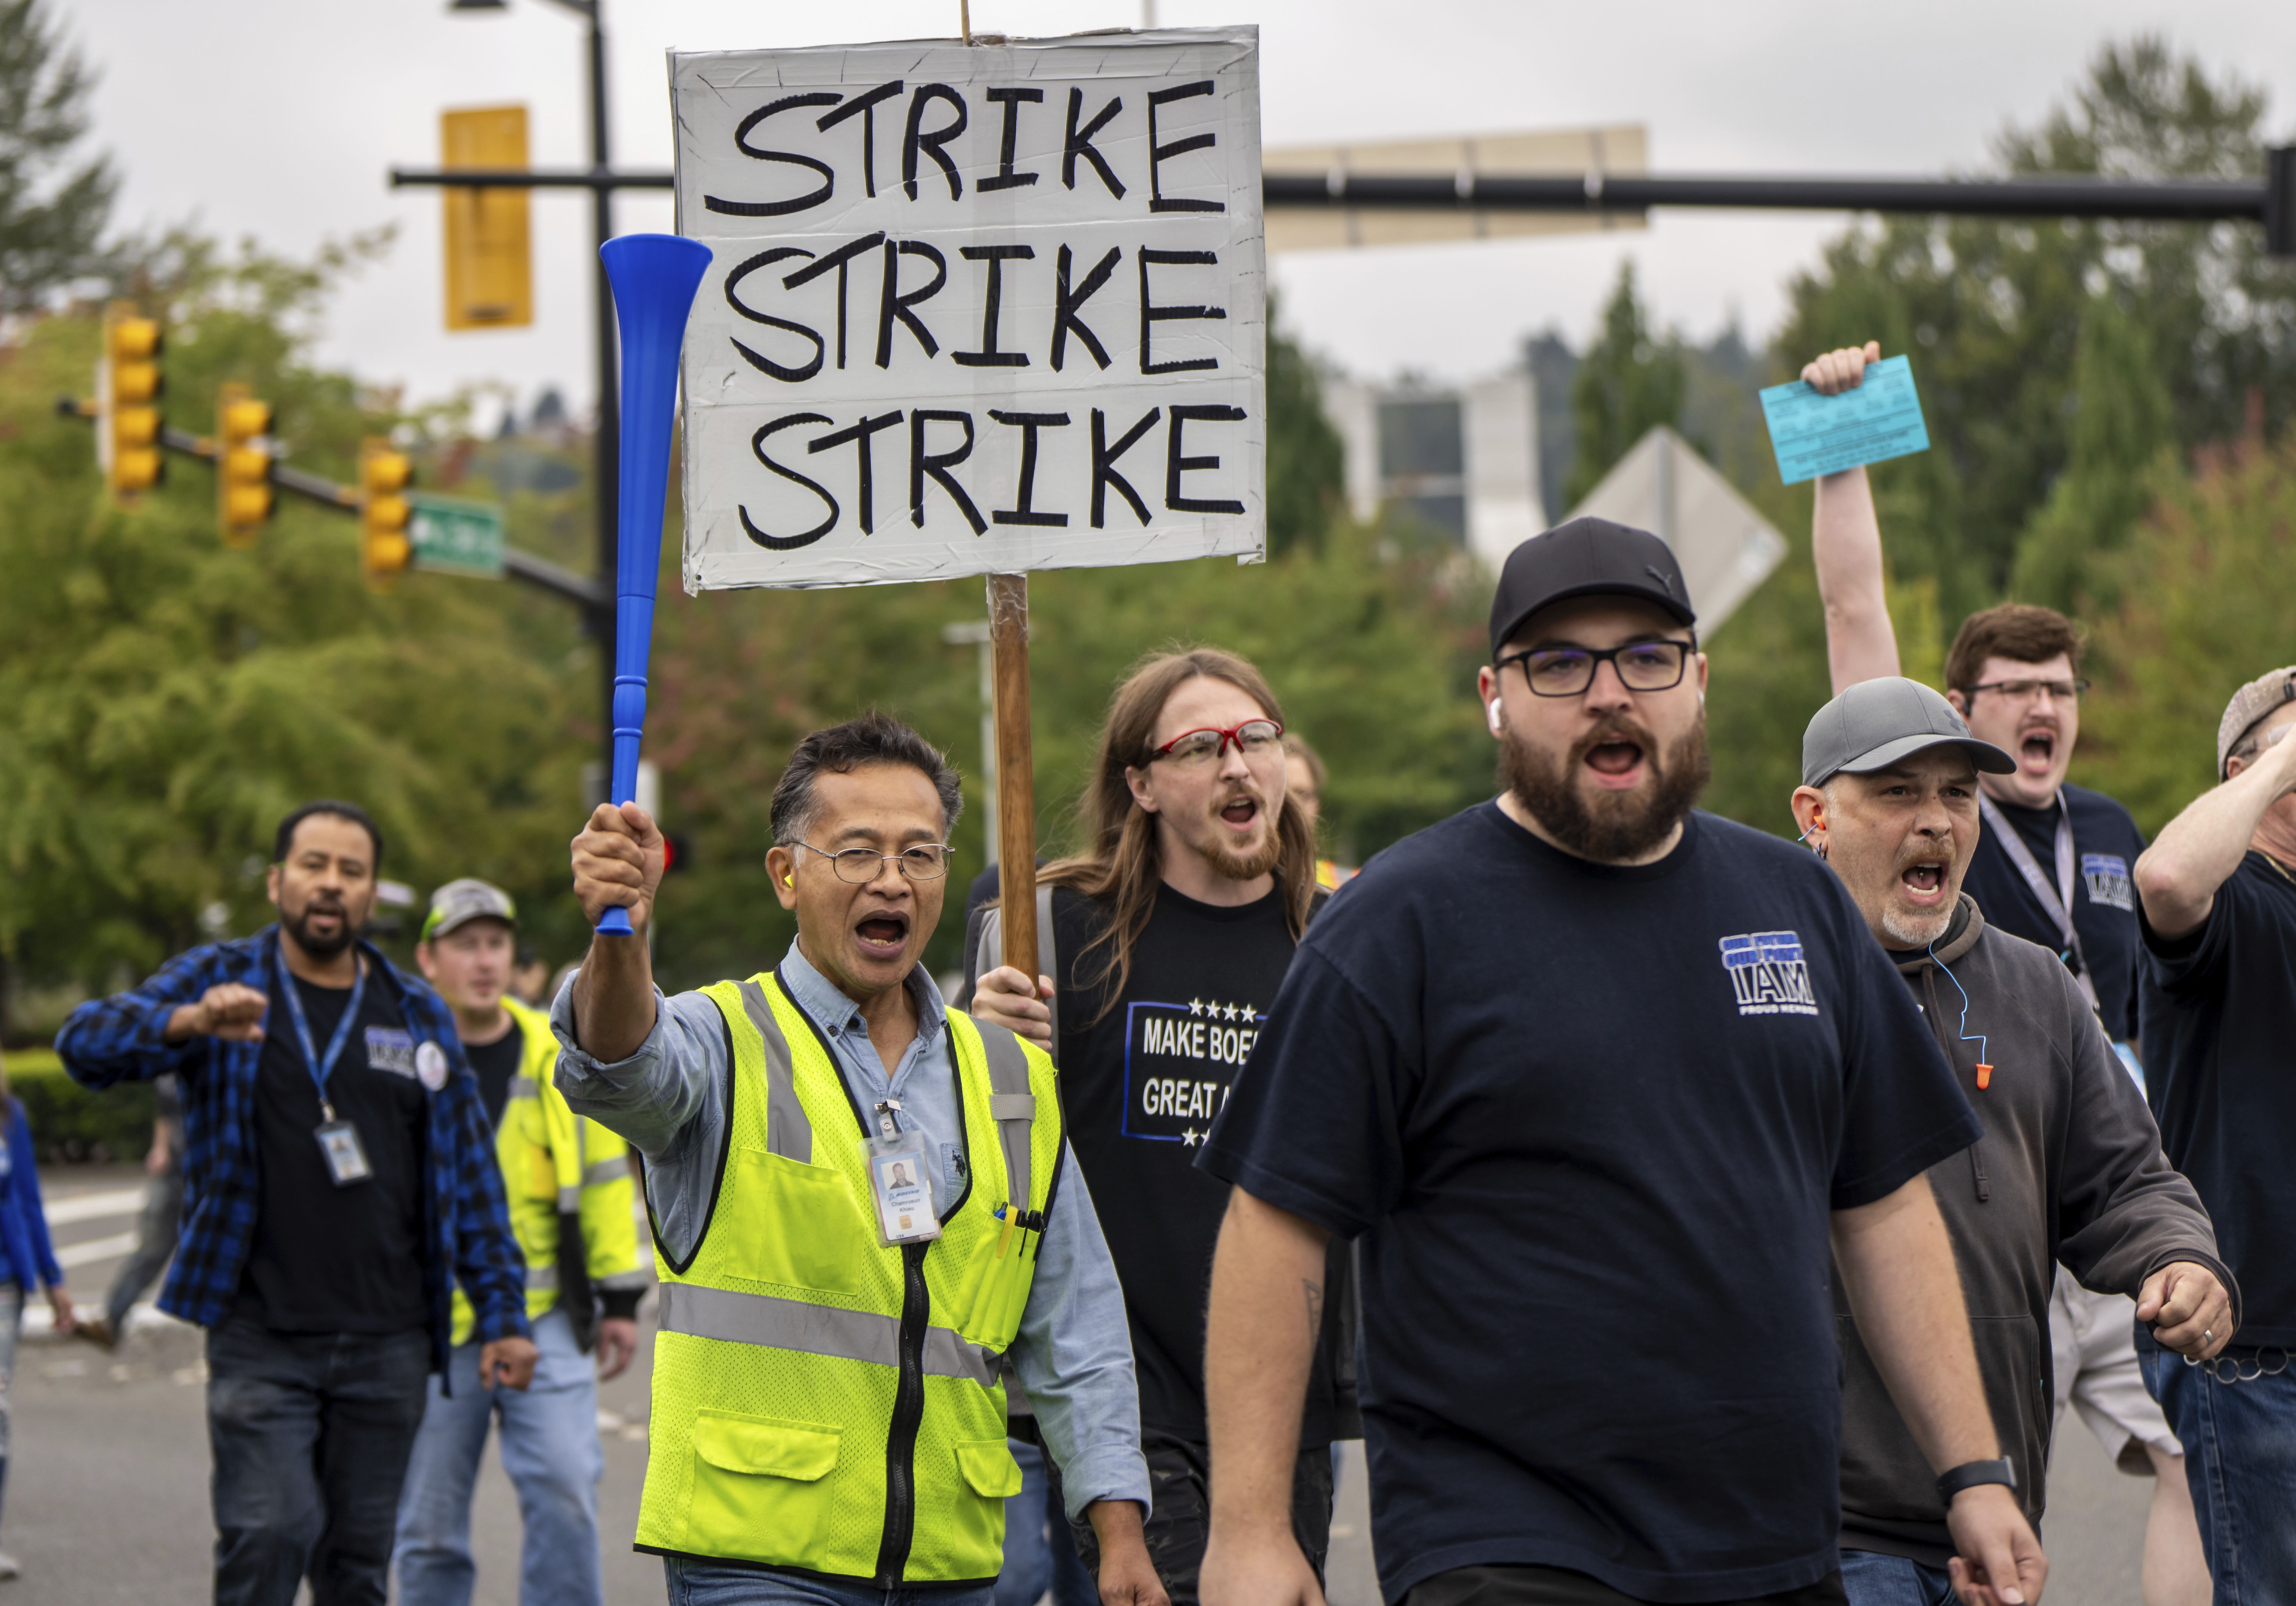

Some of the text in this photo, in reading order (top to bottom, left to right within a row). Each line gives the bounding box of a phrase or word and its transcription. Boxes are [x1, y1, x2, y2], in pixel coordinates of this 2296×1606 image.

[705, 80, 1225, 217] STRIKE
[725, 232, 1226, 382] STRIKE
[739, 405, 1247, 550] STRIKE
[1729, 960, 1816, 1005] IAM
[1144, 1018, 1205, 1058] MAKE
[1143, 1078, 1217, 1119] GREAT
[891, 1198, 920, 1207] Chamroeun
